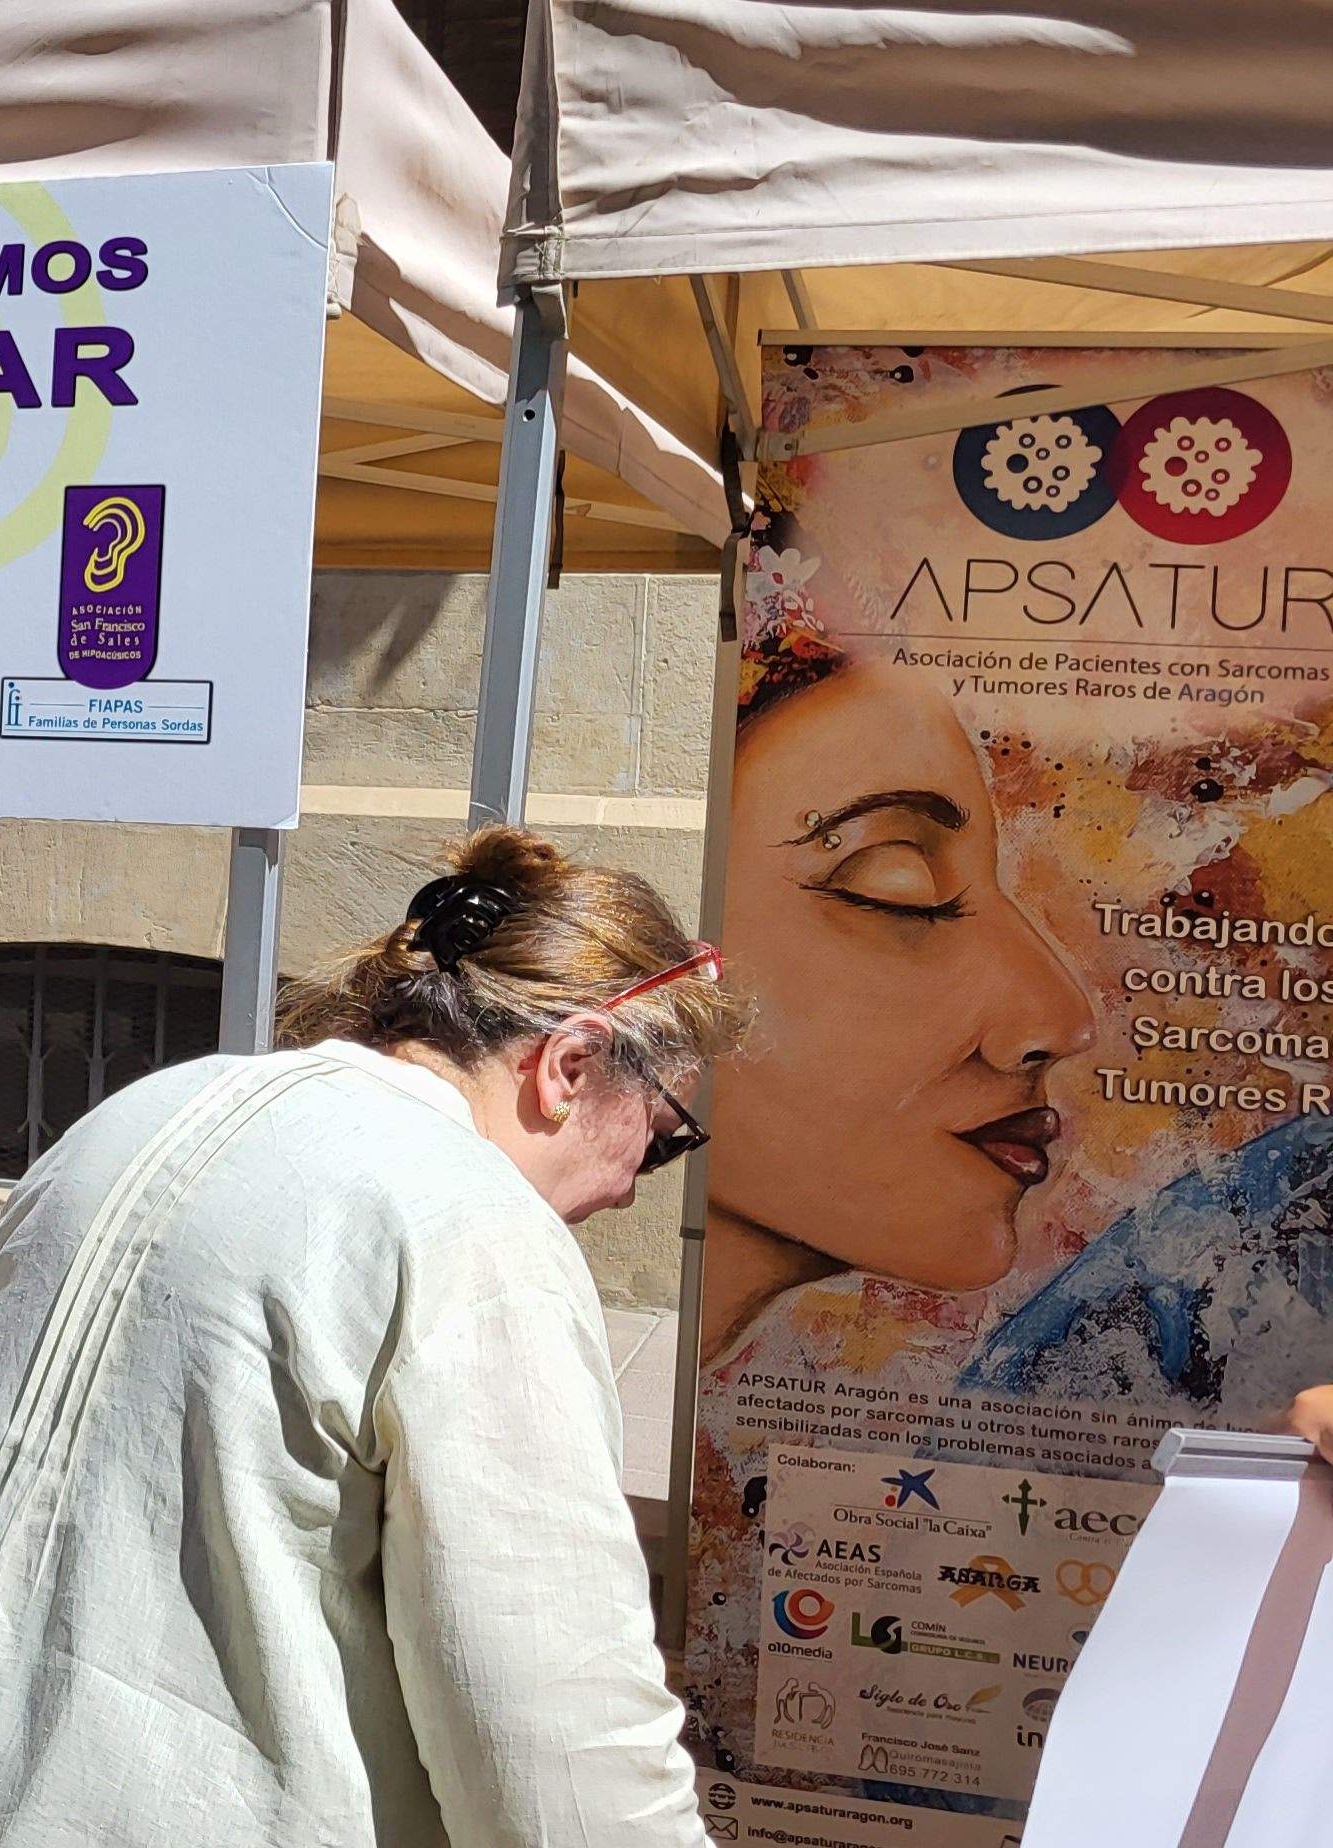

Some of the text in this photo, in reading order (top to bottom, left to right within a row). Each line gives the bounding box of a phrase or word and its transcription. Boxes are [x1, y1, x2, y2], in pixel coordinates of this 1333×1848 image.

[890, 556, 1333, 633] APSATUR
[71, 604, 143, 616] ASOCIACIÓN
[71, 617, 145, 633] San Francisco
[70, 633, 140, 646] de Sales
[69, 651, 80, 660] DE
[892, 648, 1329, 682] Asociación de Pacientes con Sarcomas
[952, 675, 1265, 708] y Tumores Raros de Aragón
[88, 698, 144, 714] FIAPAS
[28, 716, 204, 732] Familias de Personas Sordas
[1094, 902, 1333, 949] Trabajando
[1124, 965, 1266, 999] contra
[1133, 1016, 1330, 1059] Sarcoma
[1096, 1068, 1331, 1116] Tumores R
[737, 1373, 826, 1395] APSATUR
[834, 1383, 899, 1403] Aragón
[908, 1393, 929, 1405] es
[938, 1395, 972, 1410] una
[981, 1400, 1082, 1421] asociación
[1090, 1411, 1117, 1425] sin
[737, 1394, 1161, 1451] afectados por sarcomas u otros tumores raros
[735, 1413, 862, 1439] sensibilizadas
[867, 1430, 900, 1443] con
[906, 1431, 932, 1447] los
[938, 1437, 1036, 1459] problemas
[1041, 1445, 1136, 1468] asociados
[777, 1453, 856, 1473] Colaboran:
[833, 1508, 872, 1525] Obra
[875, 1513, 919, 1530] Social
[1053, 1506, 1145, 1536] aec
[816, 1538, 882, 1563] AEAS
[767, 1567, 922, 1595] de Afectados por Sarcomas
[815, 1560, 923, 1582] Asociación Española
[1013, 1652, 1074, 1673] NEUR
[859, 1683, 904, 1709] Siglo
[908, 1692, 927, 1707] de
[772, 1728, 835, 1746] RESIDENCIA
[861, 1732, 981, 1757] Francisco José Sanz
[1016, 1724, 1044, 1748] in
[889, 1763, 981, 1788] 695 772 314
[750, 1796, 913, 1830] www.apsaturaragon.org
[747, 1826, 886, 1848] info@apsaturarag
